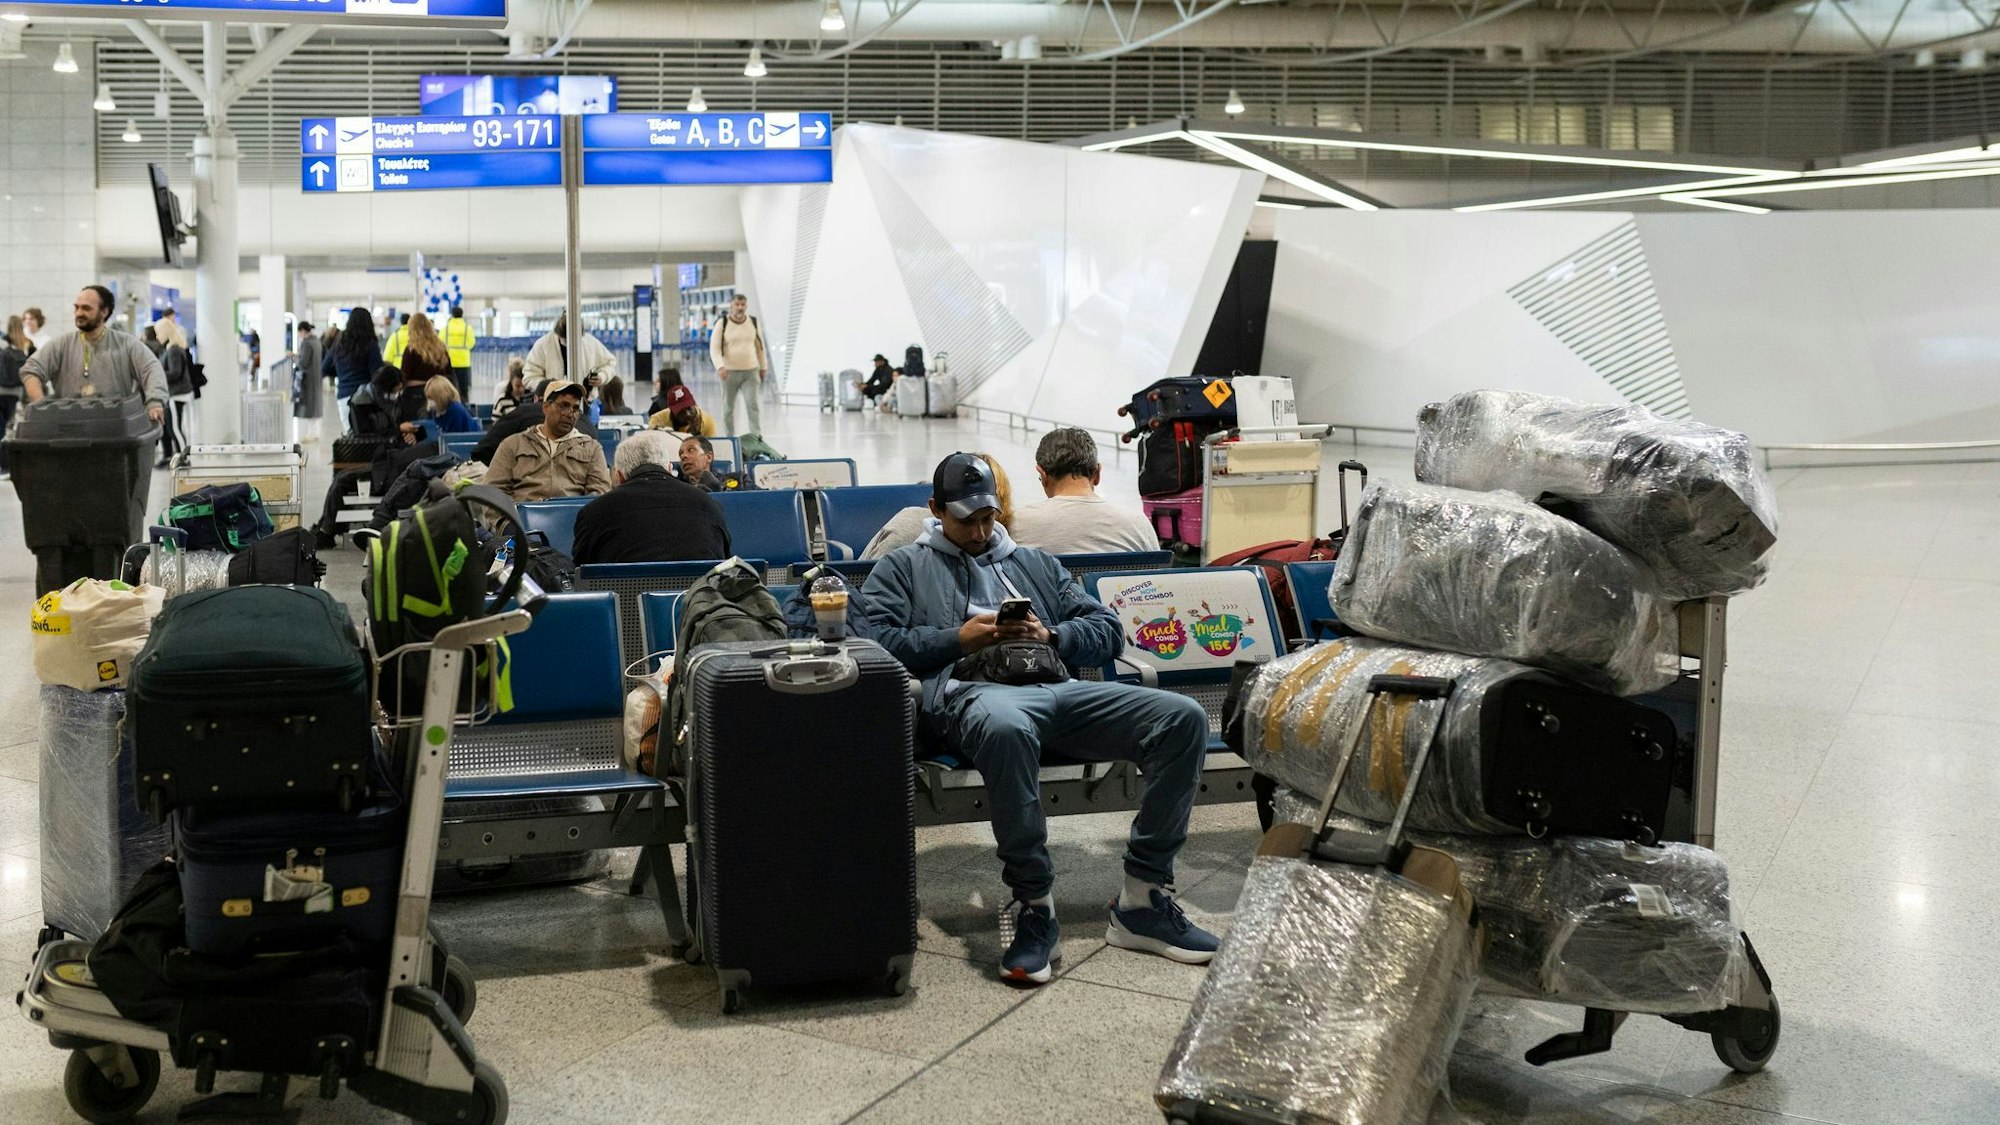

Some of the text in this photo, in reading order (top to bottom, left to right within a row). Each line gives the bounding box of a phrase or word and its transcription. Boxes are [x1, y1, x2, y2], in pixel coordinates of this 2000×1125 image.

[472, 119, 553, 147] 93-171
[686, 117, 764, 148] A, B, C
[375, 136, 414, 150] Check-in
[378, 172, 409, 185] Toilets
[1121, 580, 1153, 597] DISCOVER
[1140, 587, 1157, 595] NOW
[1129, 591, 1174, 603] THE COMBOS
[1154, 634, 1179, 642] COMBO
[1210, 631, 1235, 639] COMBO
[1158, 642, 1176, 654] 9€
[1208, 639, 1231, 651] 15€
